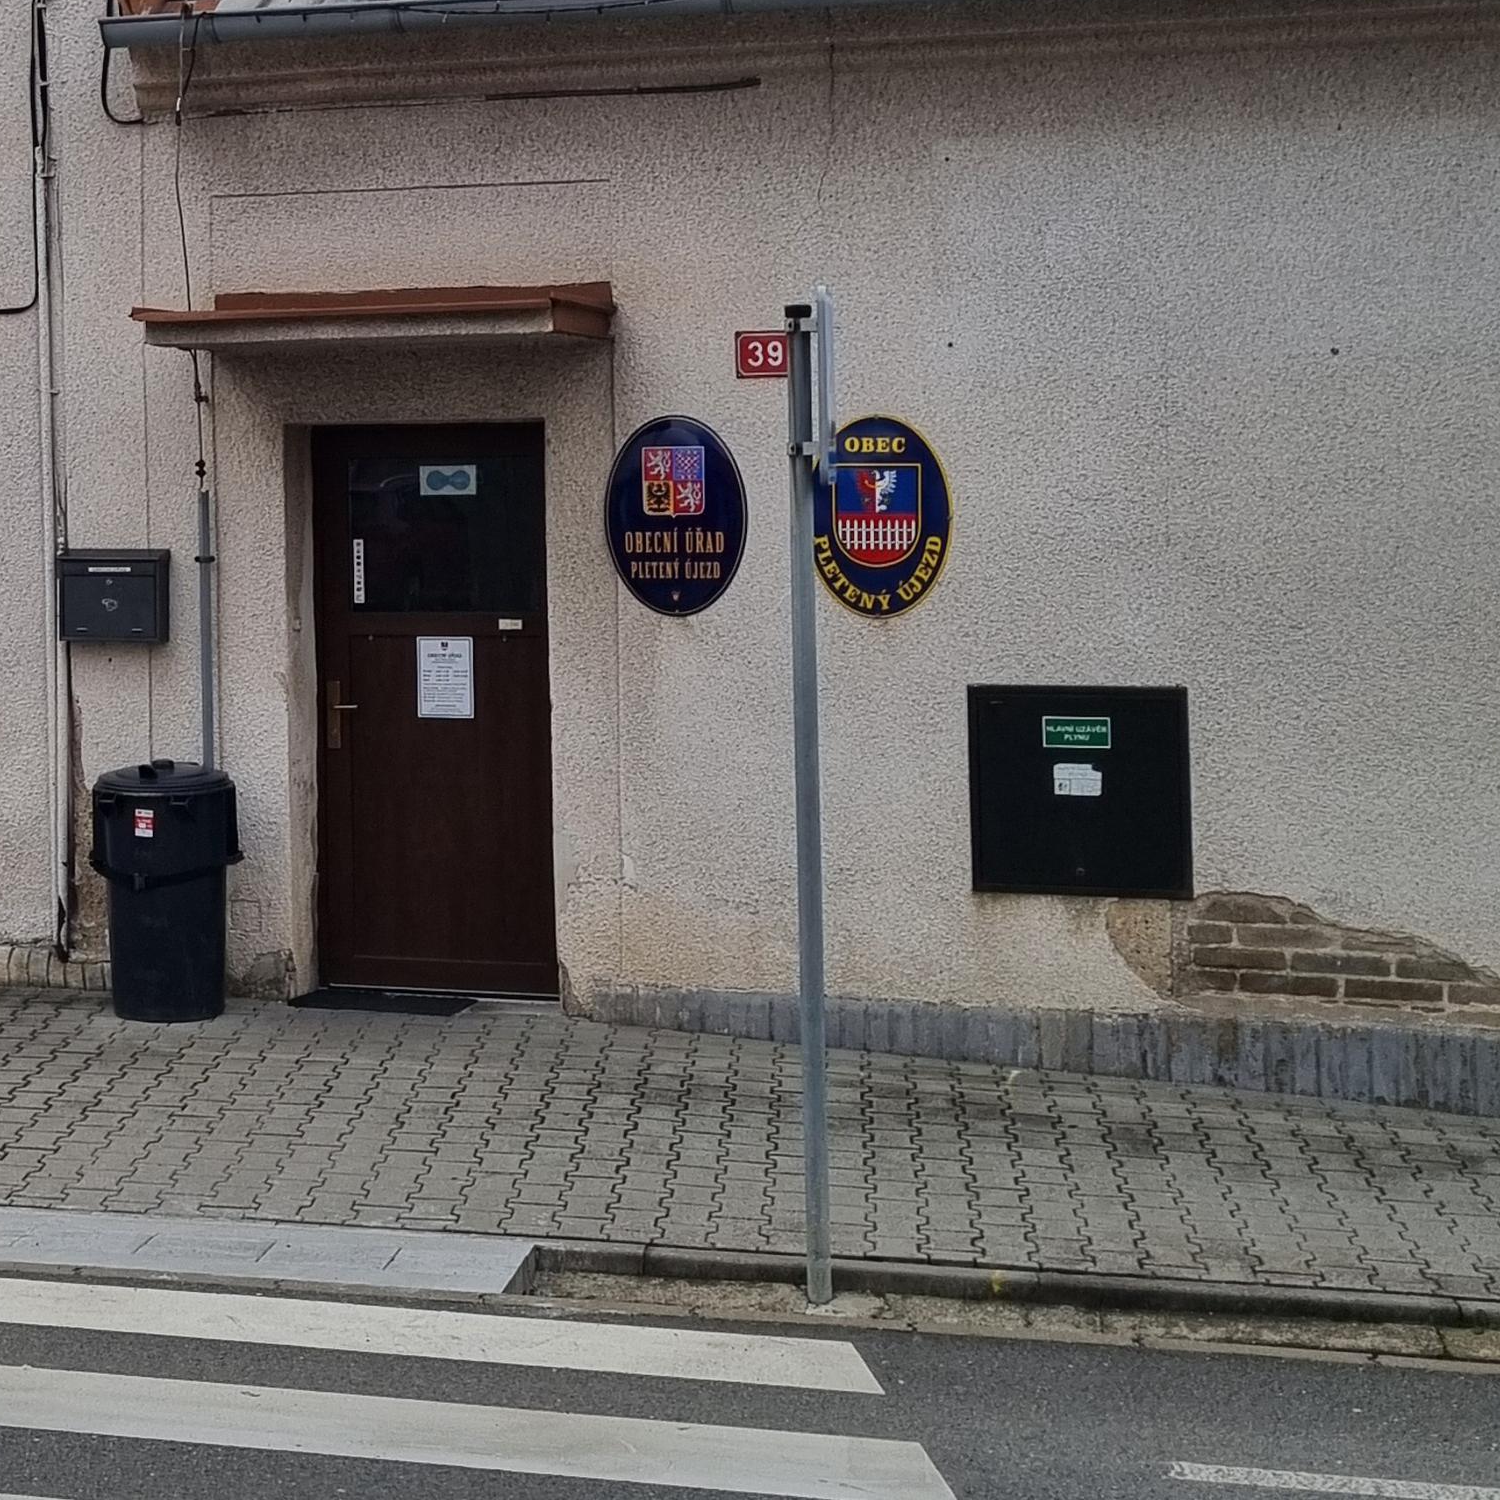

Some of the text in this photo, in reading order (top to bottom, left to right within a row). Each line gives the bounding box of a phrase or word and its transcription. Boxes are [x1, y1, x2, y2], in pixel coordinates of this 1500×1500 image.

[747, 340, 783, 367] 39
[844, 436, 906, 453] OBEC
[624, 527, 725, 554] OBECNÍ ÚŘAD
[630, 558, 721, 579] PLETENÝ ÚJEZD
[814, 534, 942, 611] PLETENÝ ÚJEZD
